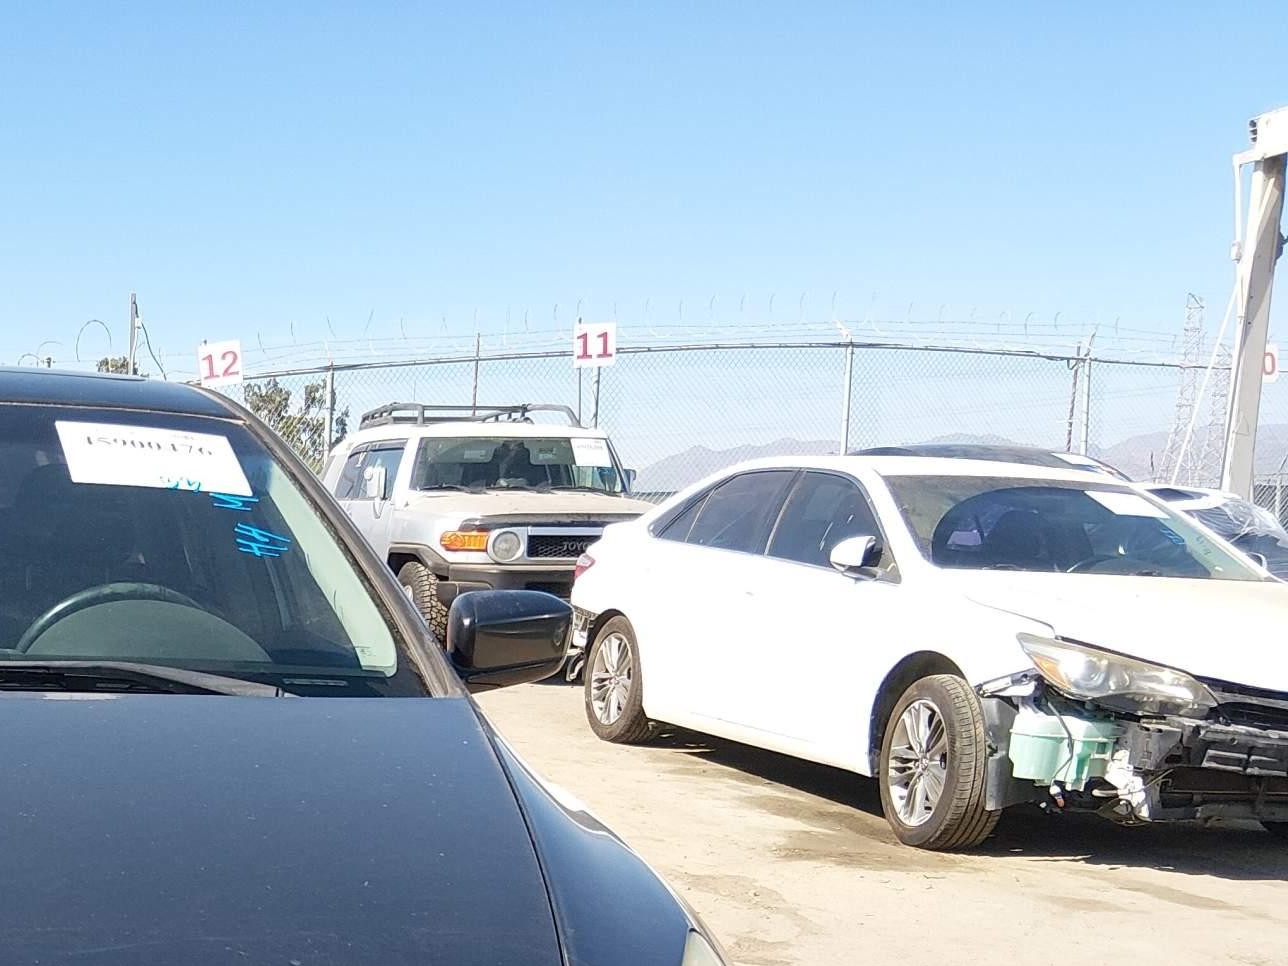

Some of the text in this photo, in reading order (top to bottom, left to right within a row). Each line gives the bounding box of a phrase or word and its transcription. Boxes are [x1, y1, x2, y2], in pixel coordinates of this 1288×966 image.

[576, 331, 613, 360] 11
[201, 350, 240, 380] 12
[1263, 352, 1276, 375] 0
[562, 541, 592, 551] TOYO
